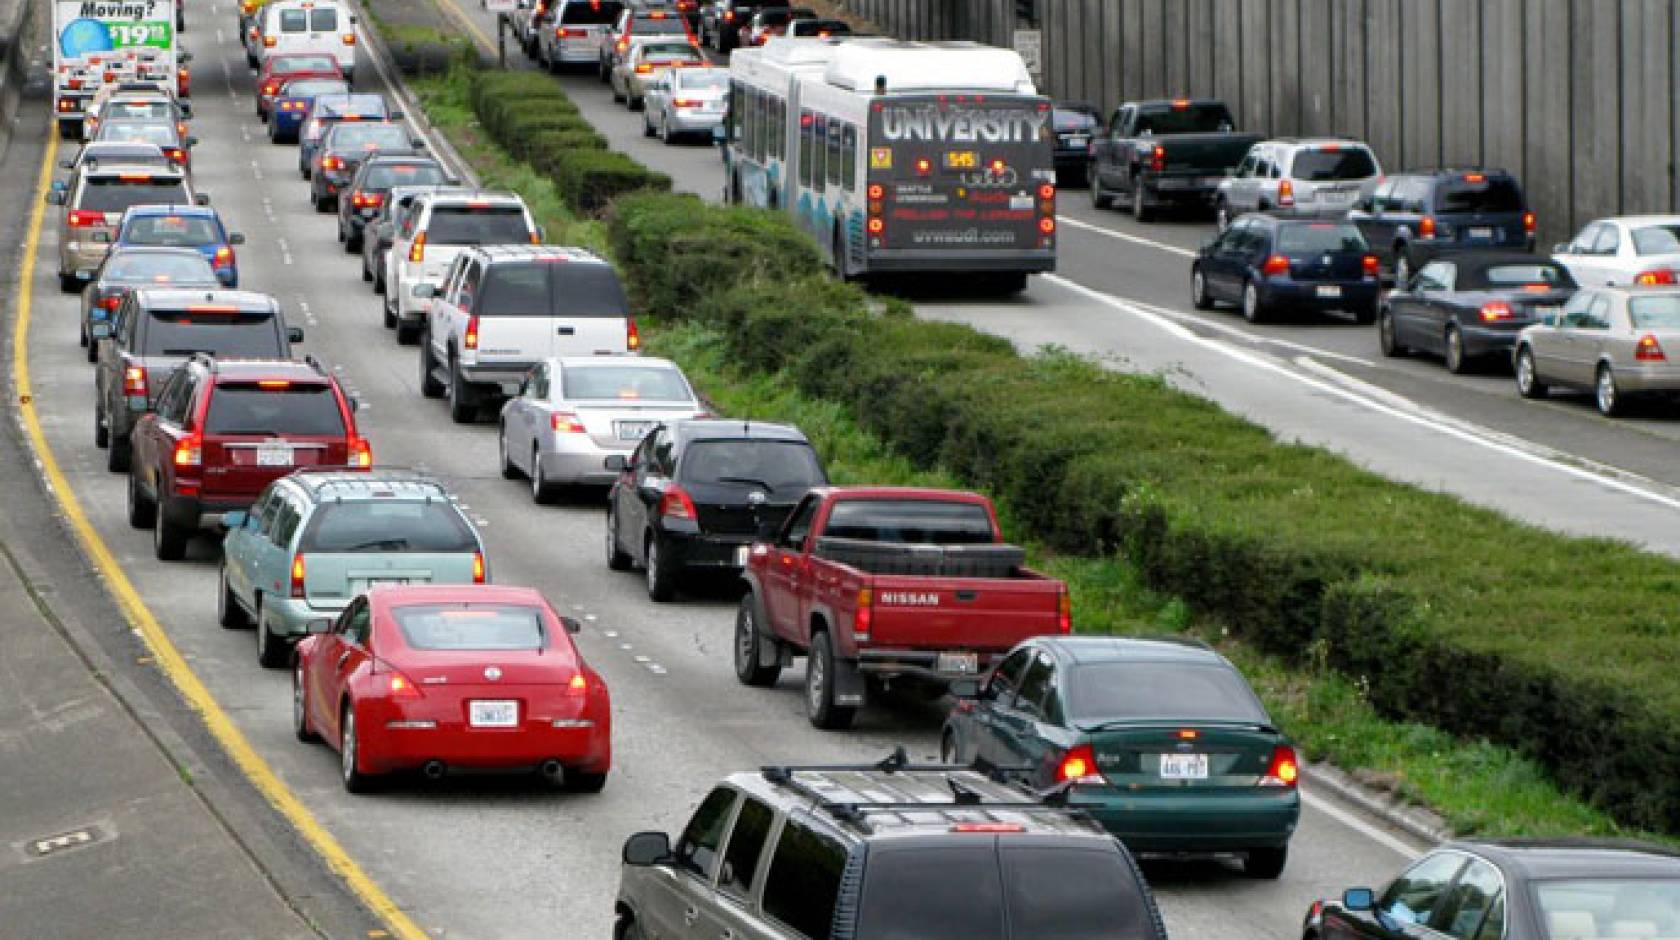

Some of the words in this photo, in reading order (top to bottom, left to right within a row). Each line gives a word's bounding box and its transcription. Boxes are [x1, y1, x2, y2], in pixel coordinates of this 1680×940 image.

[80, 0, 155, 20] Moving?
[881, 107, 1048, 141] UNIVERSITY
[881, 591, 939, 605] NISSAN
